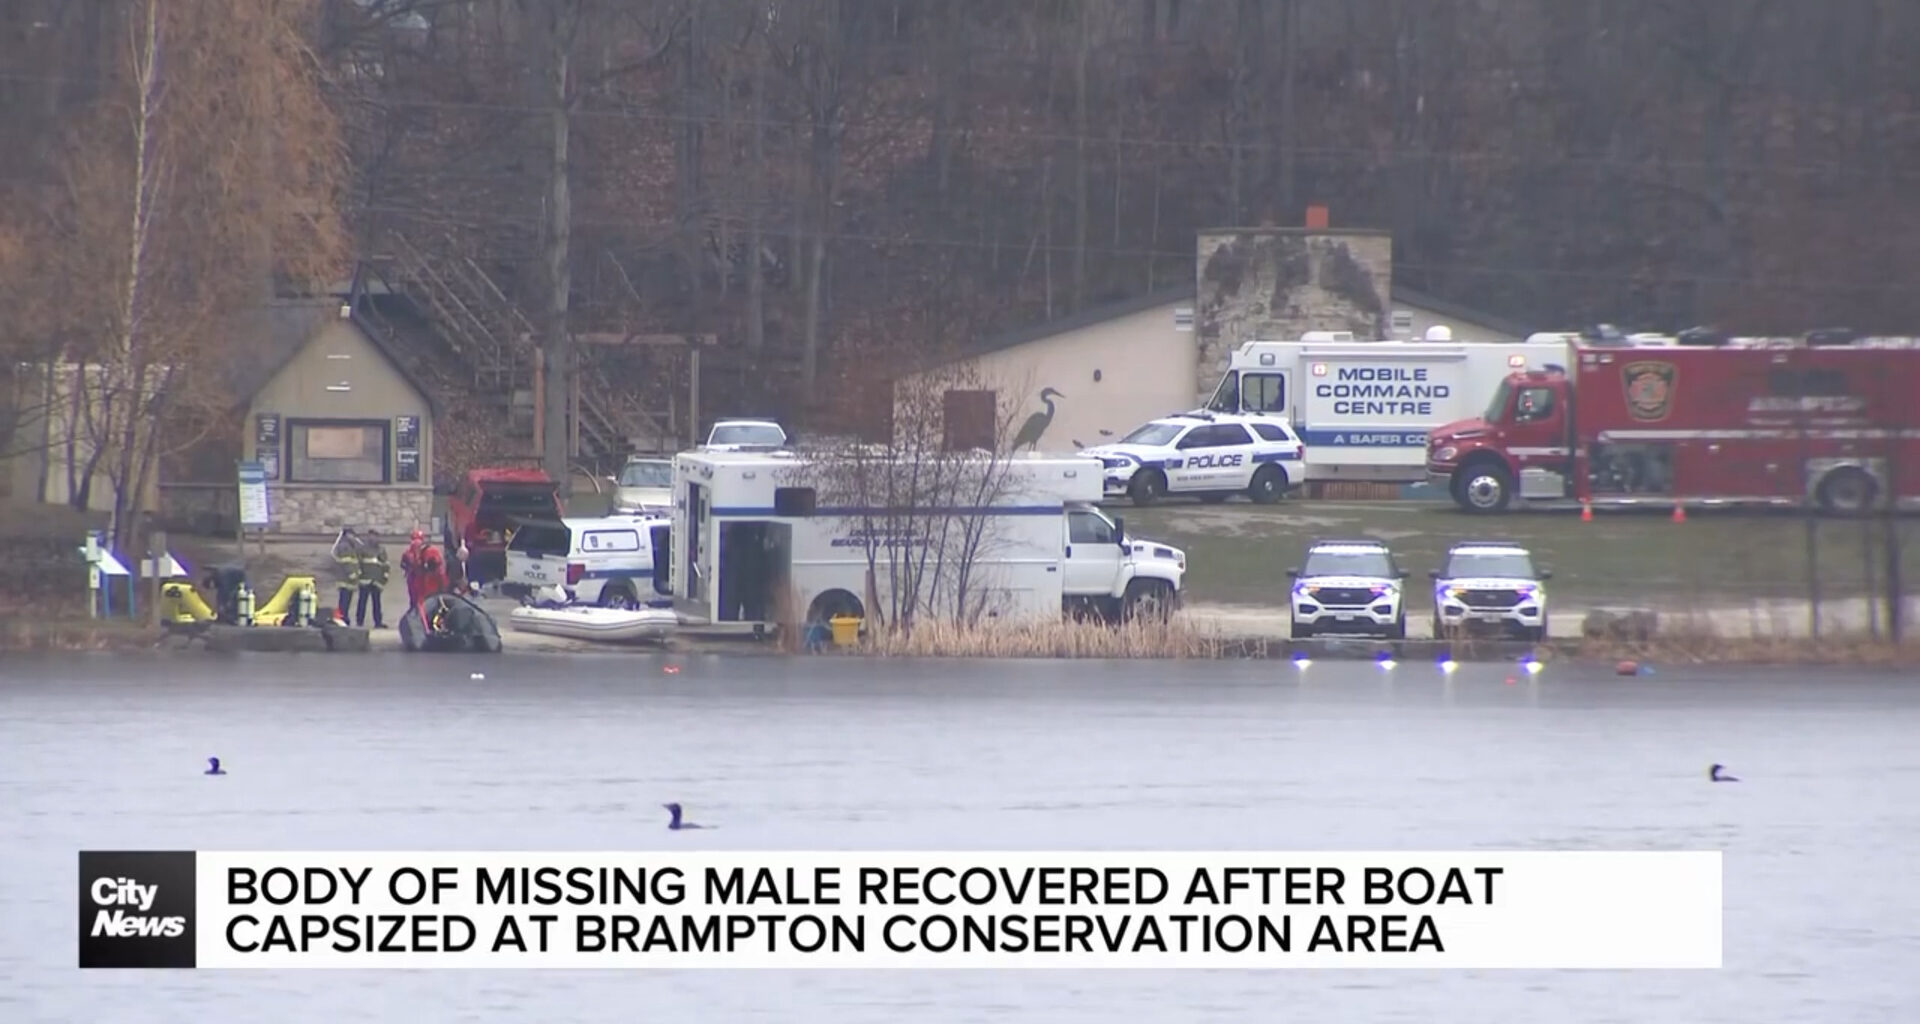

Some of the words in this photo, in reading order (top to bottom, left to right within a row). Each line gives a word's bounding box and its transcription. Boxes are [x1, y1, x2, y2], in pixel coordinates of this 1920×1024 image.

[1338, 368, 1427, 381] MOBILE
[1316, 384, 1449, 398] COMMAND
[1334, 401, 1432, 415] CENTRE
[1333, 434, 1345, 444] A
[1350, 434, 1401, 444] SAFER
[1187, 454, 1243, 469] POLICE
[523, 570, 547, 580] POLICE
